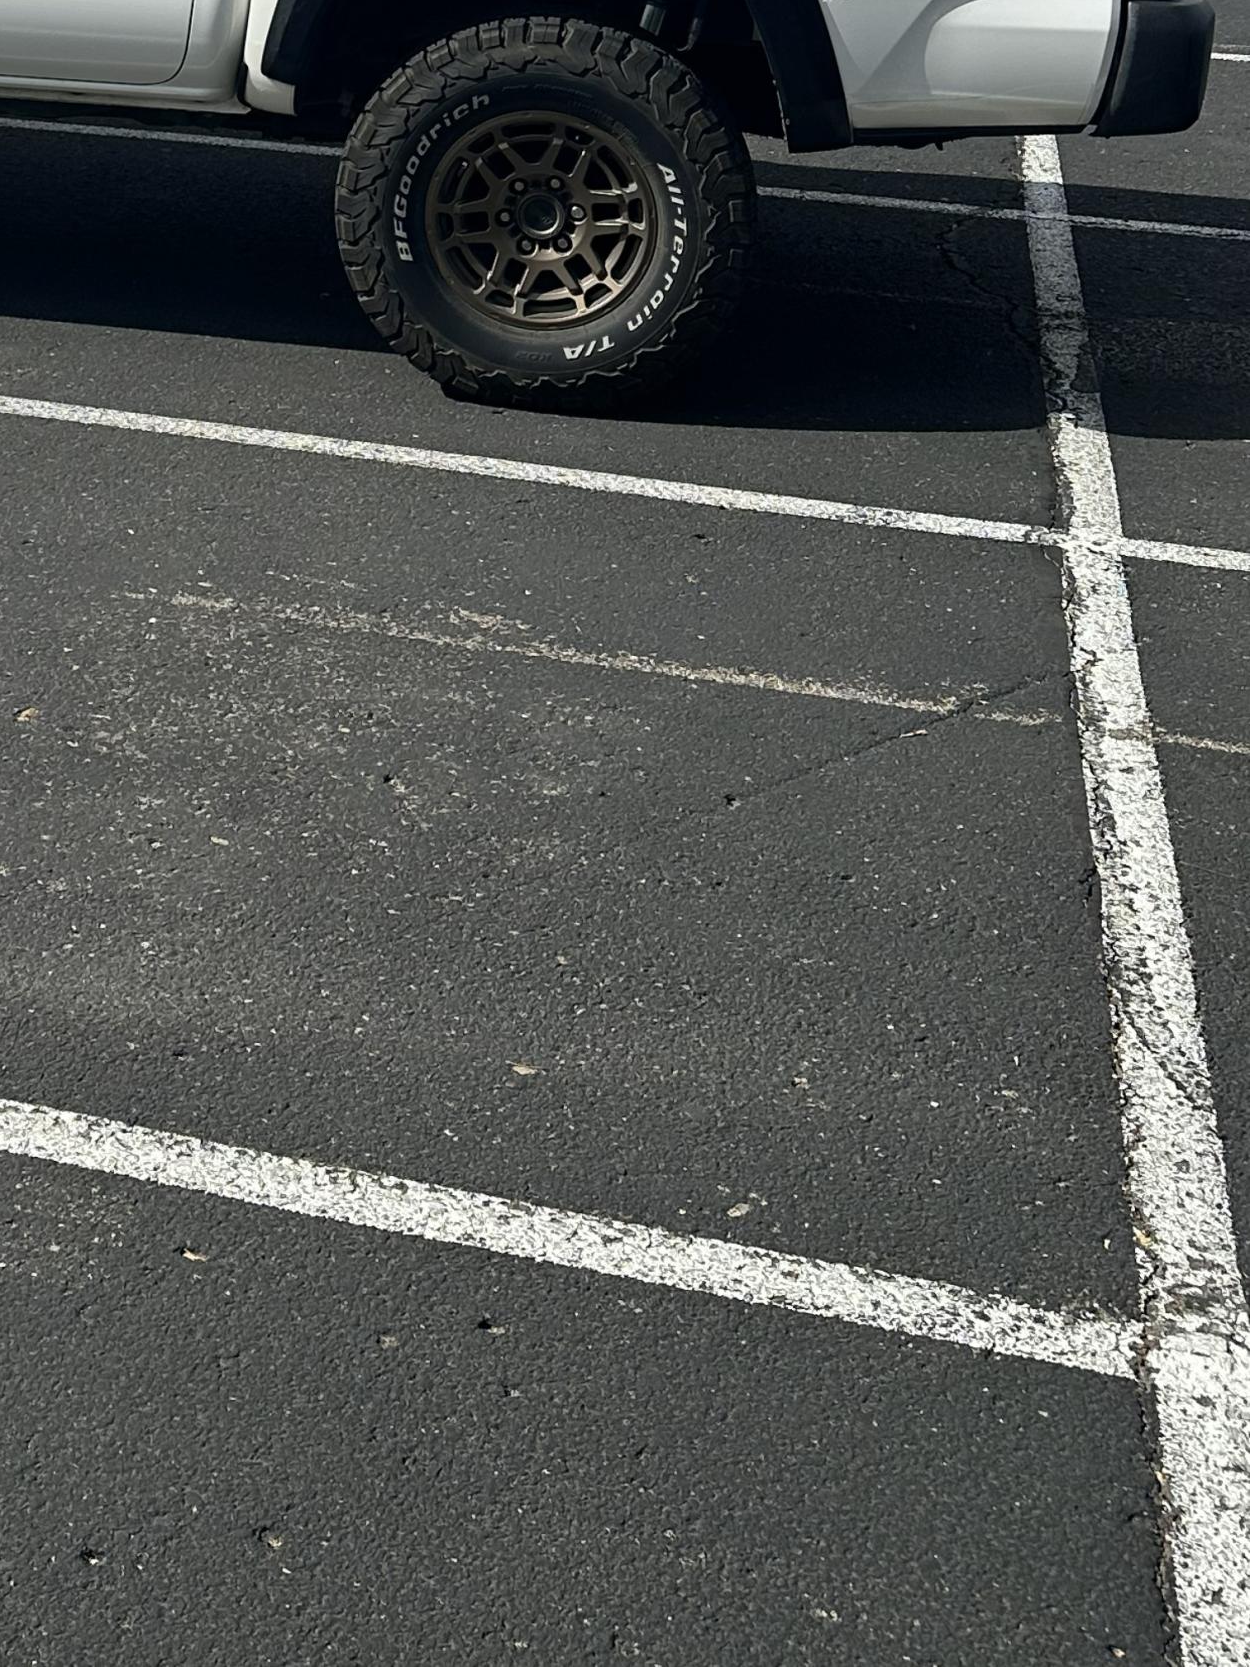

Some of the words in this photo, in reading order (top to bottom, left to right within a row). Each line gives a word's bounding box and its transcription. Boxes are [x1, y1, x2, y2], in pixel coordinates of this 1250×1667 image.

[393, 94, 490, 262] BFGoodrich
[626, 162, 688, 332] All-Terrain
[563, 335, 615, 360] T/A
